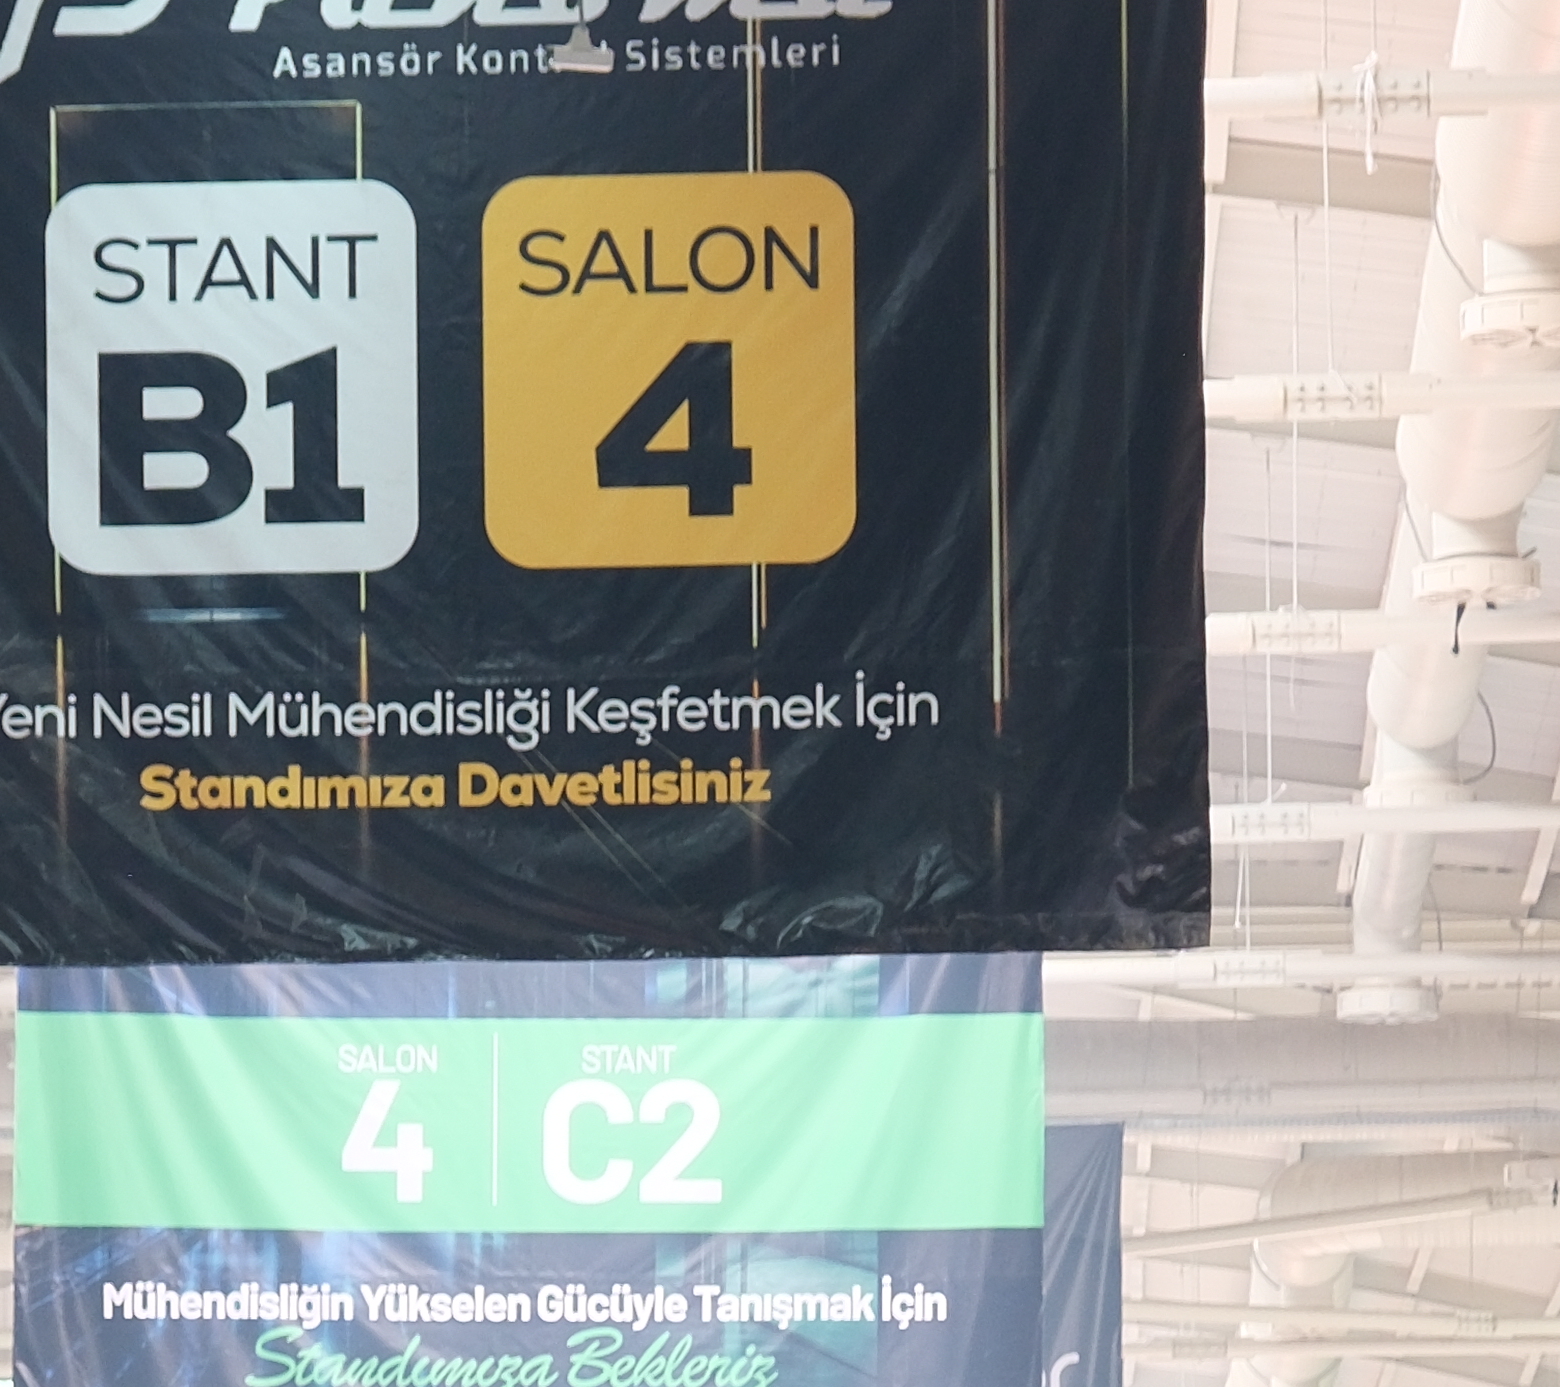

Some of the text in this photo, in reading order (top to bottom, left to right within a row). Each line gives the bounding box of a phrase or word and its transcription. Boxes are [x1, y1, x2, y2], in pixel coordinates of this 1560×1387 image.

[273, 42, 441, 79] Asansör
[457, 39, 612, 75] Kont
[626, 34, 842, 72] Sistemleri
[92, 231, 378, 303] STANT
[518, 225, 821, 298] SALON
[99, 344, 365, 526] B1
[595, 339, 752, 517] 4
[93, 688, 214, 739] Nesil
[227, 686, 552, 752] Mühendisliği
[566, 682, 843, 746] Keşfetmek
[855, 670, 940, 738] İçin
[140, 756, 773, 812] Standımıza Davetlisiniz
[337, 1044, 438, 1075] SALON
[580, 1043, 677, 1074] STANT
[340, 1078, 435, 1204] 4
[541, 1078, 724, 1205] C2
[103, 1274, 946, 1331] Mühendisliğin Yükselen Gücüyle Tanışmak İçin
